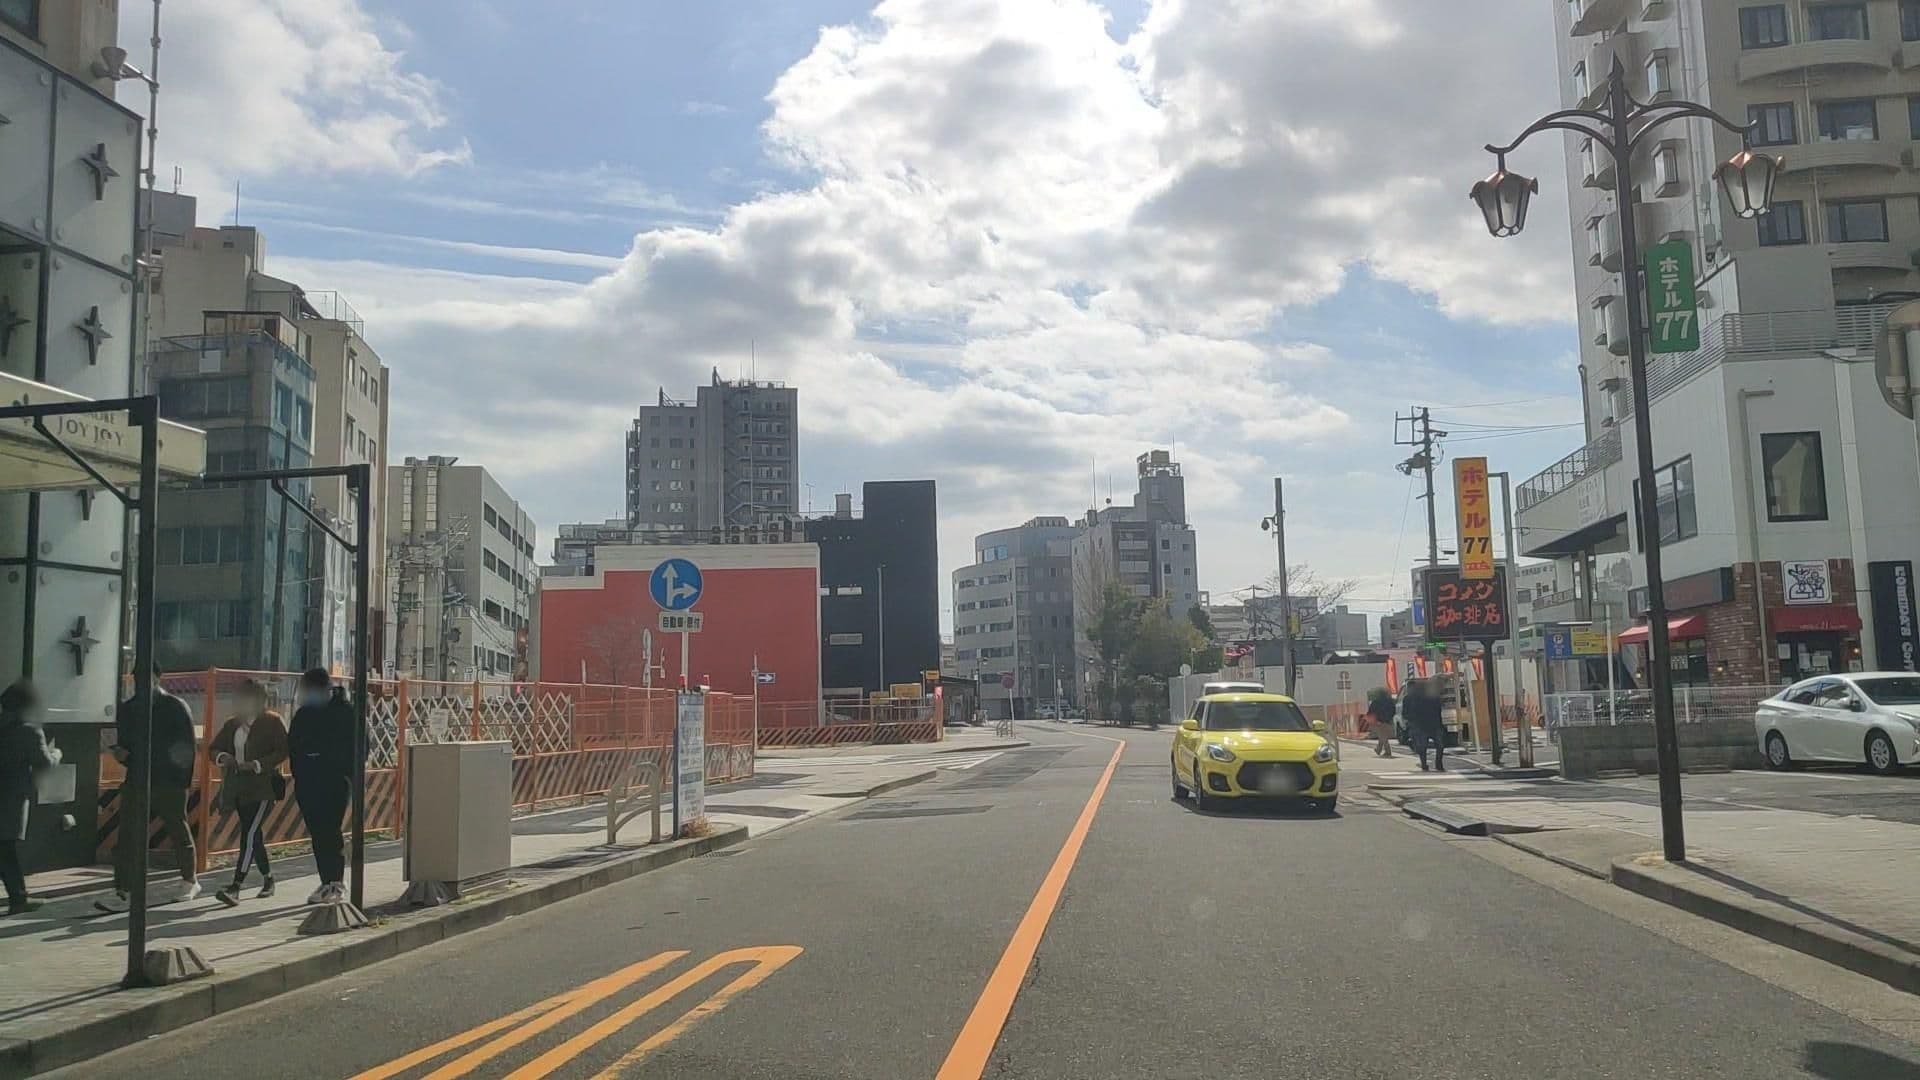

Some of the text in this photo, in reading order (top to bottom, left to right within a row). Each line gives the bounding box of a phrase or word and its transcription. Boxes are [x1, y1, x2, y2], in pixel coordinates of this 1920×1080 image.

[1659, 257, 1682, 308] ホテル
[1656, 311, 1694, 341] 77
[58, 415, 89, 438] JOY
[94, 425, 125, 447] JOY
[1462, 466, 1487, 529] ホテル
[1464, 537, 1489, 554] 77
